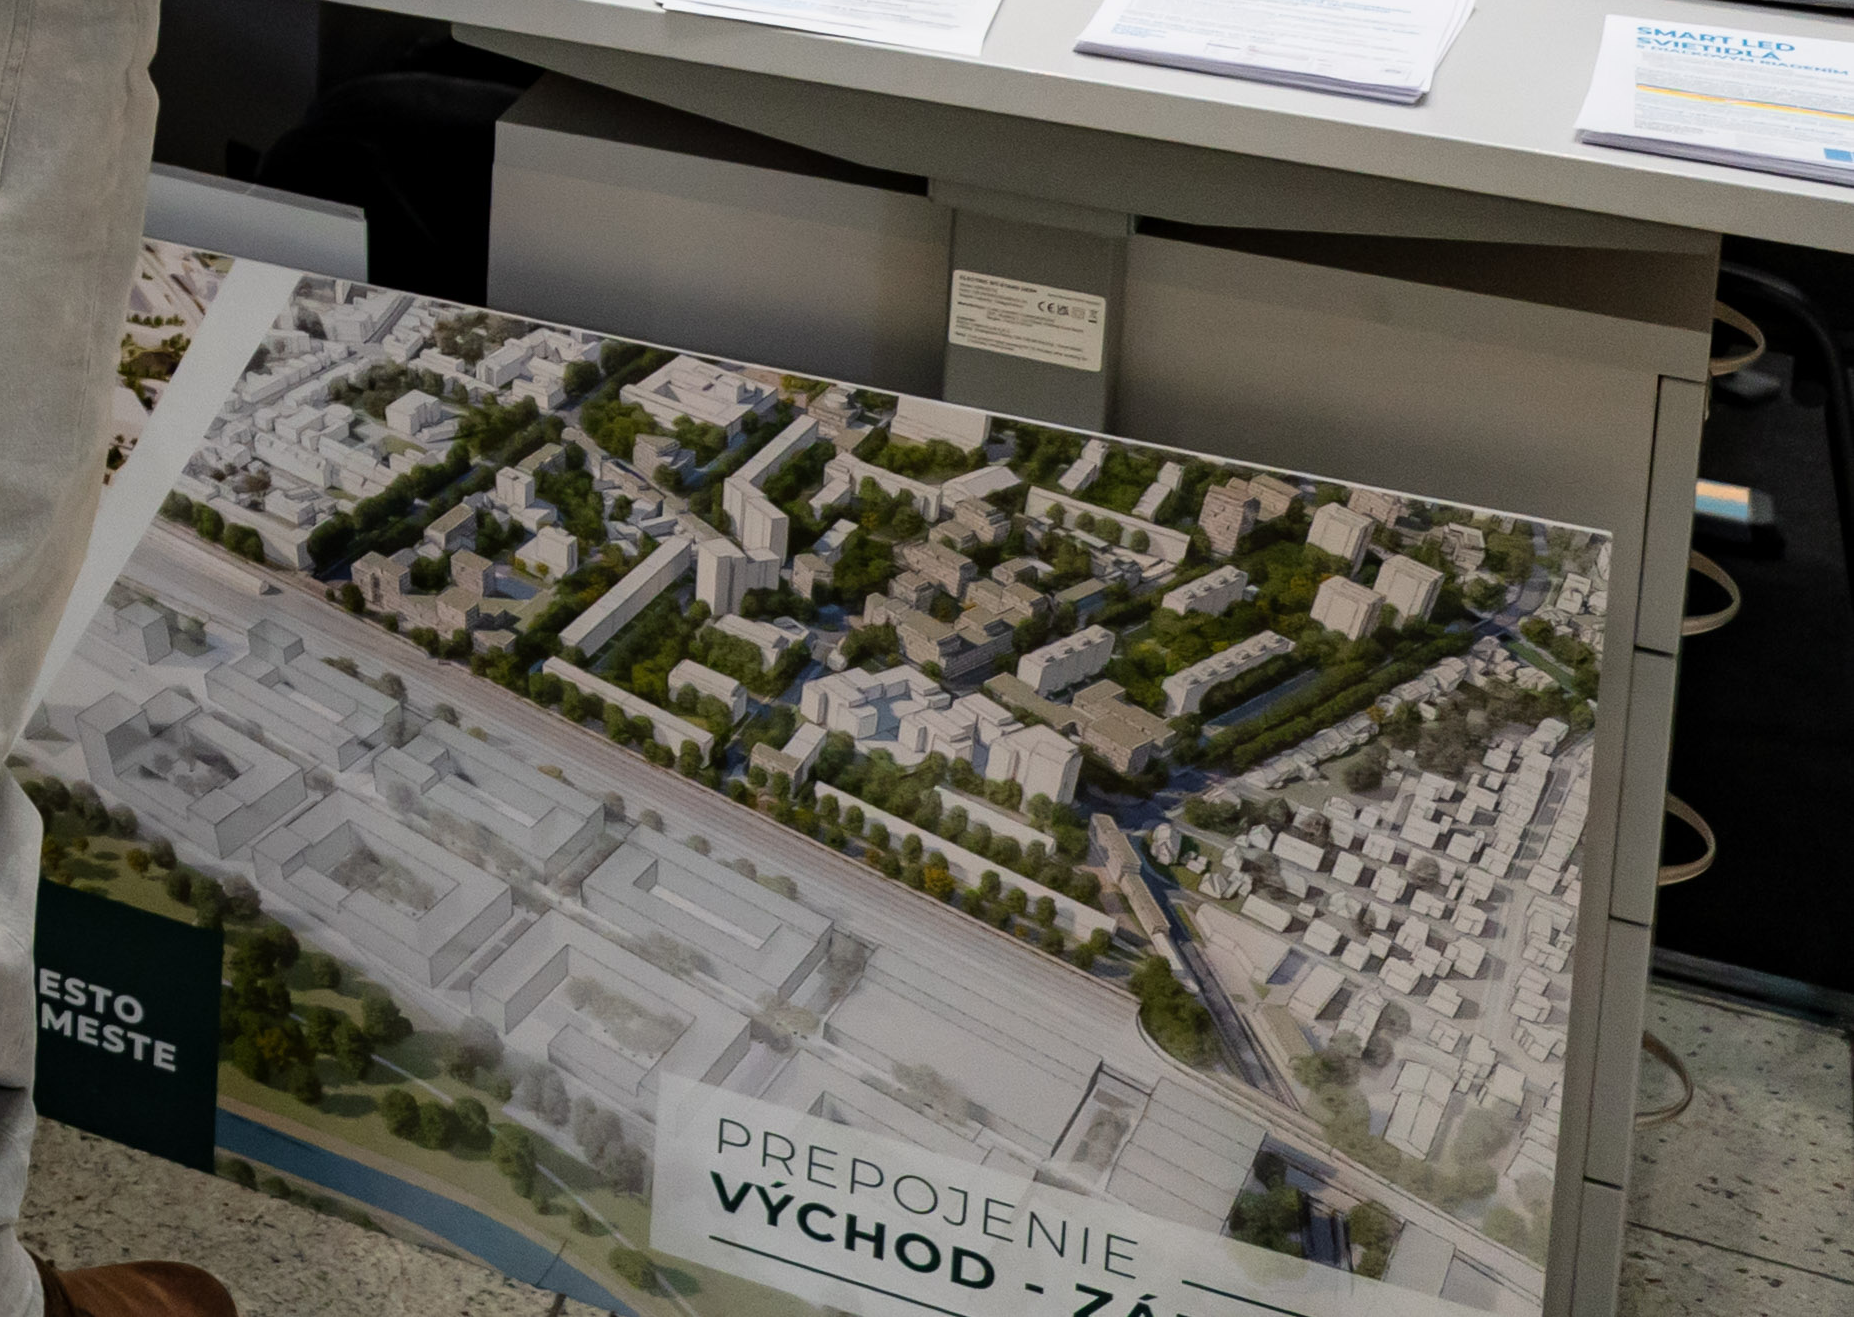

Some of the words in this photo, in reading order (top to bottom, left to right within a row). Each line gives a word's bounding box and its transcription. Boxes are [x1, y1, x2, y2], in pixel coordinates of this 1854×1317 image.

[1636, 26, 1734, 45] SMART
[1742, 38, 1796, 53] LED
[1636, 36, 1781, 61] SVIETIDLÁ
[39, 967, 144, 1024] ESTO
[41, 1002, 177, 1072] MESTE
[717, 1118, 1139, 1279] PREPOJENIE
[710, 1171, 996, 1290] VÝCHOD
